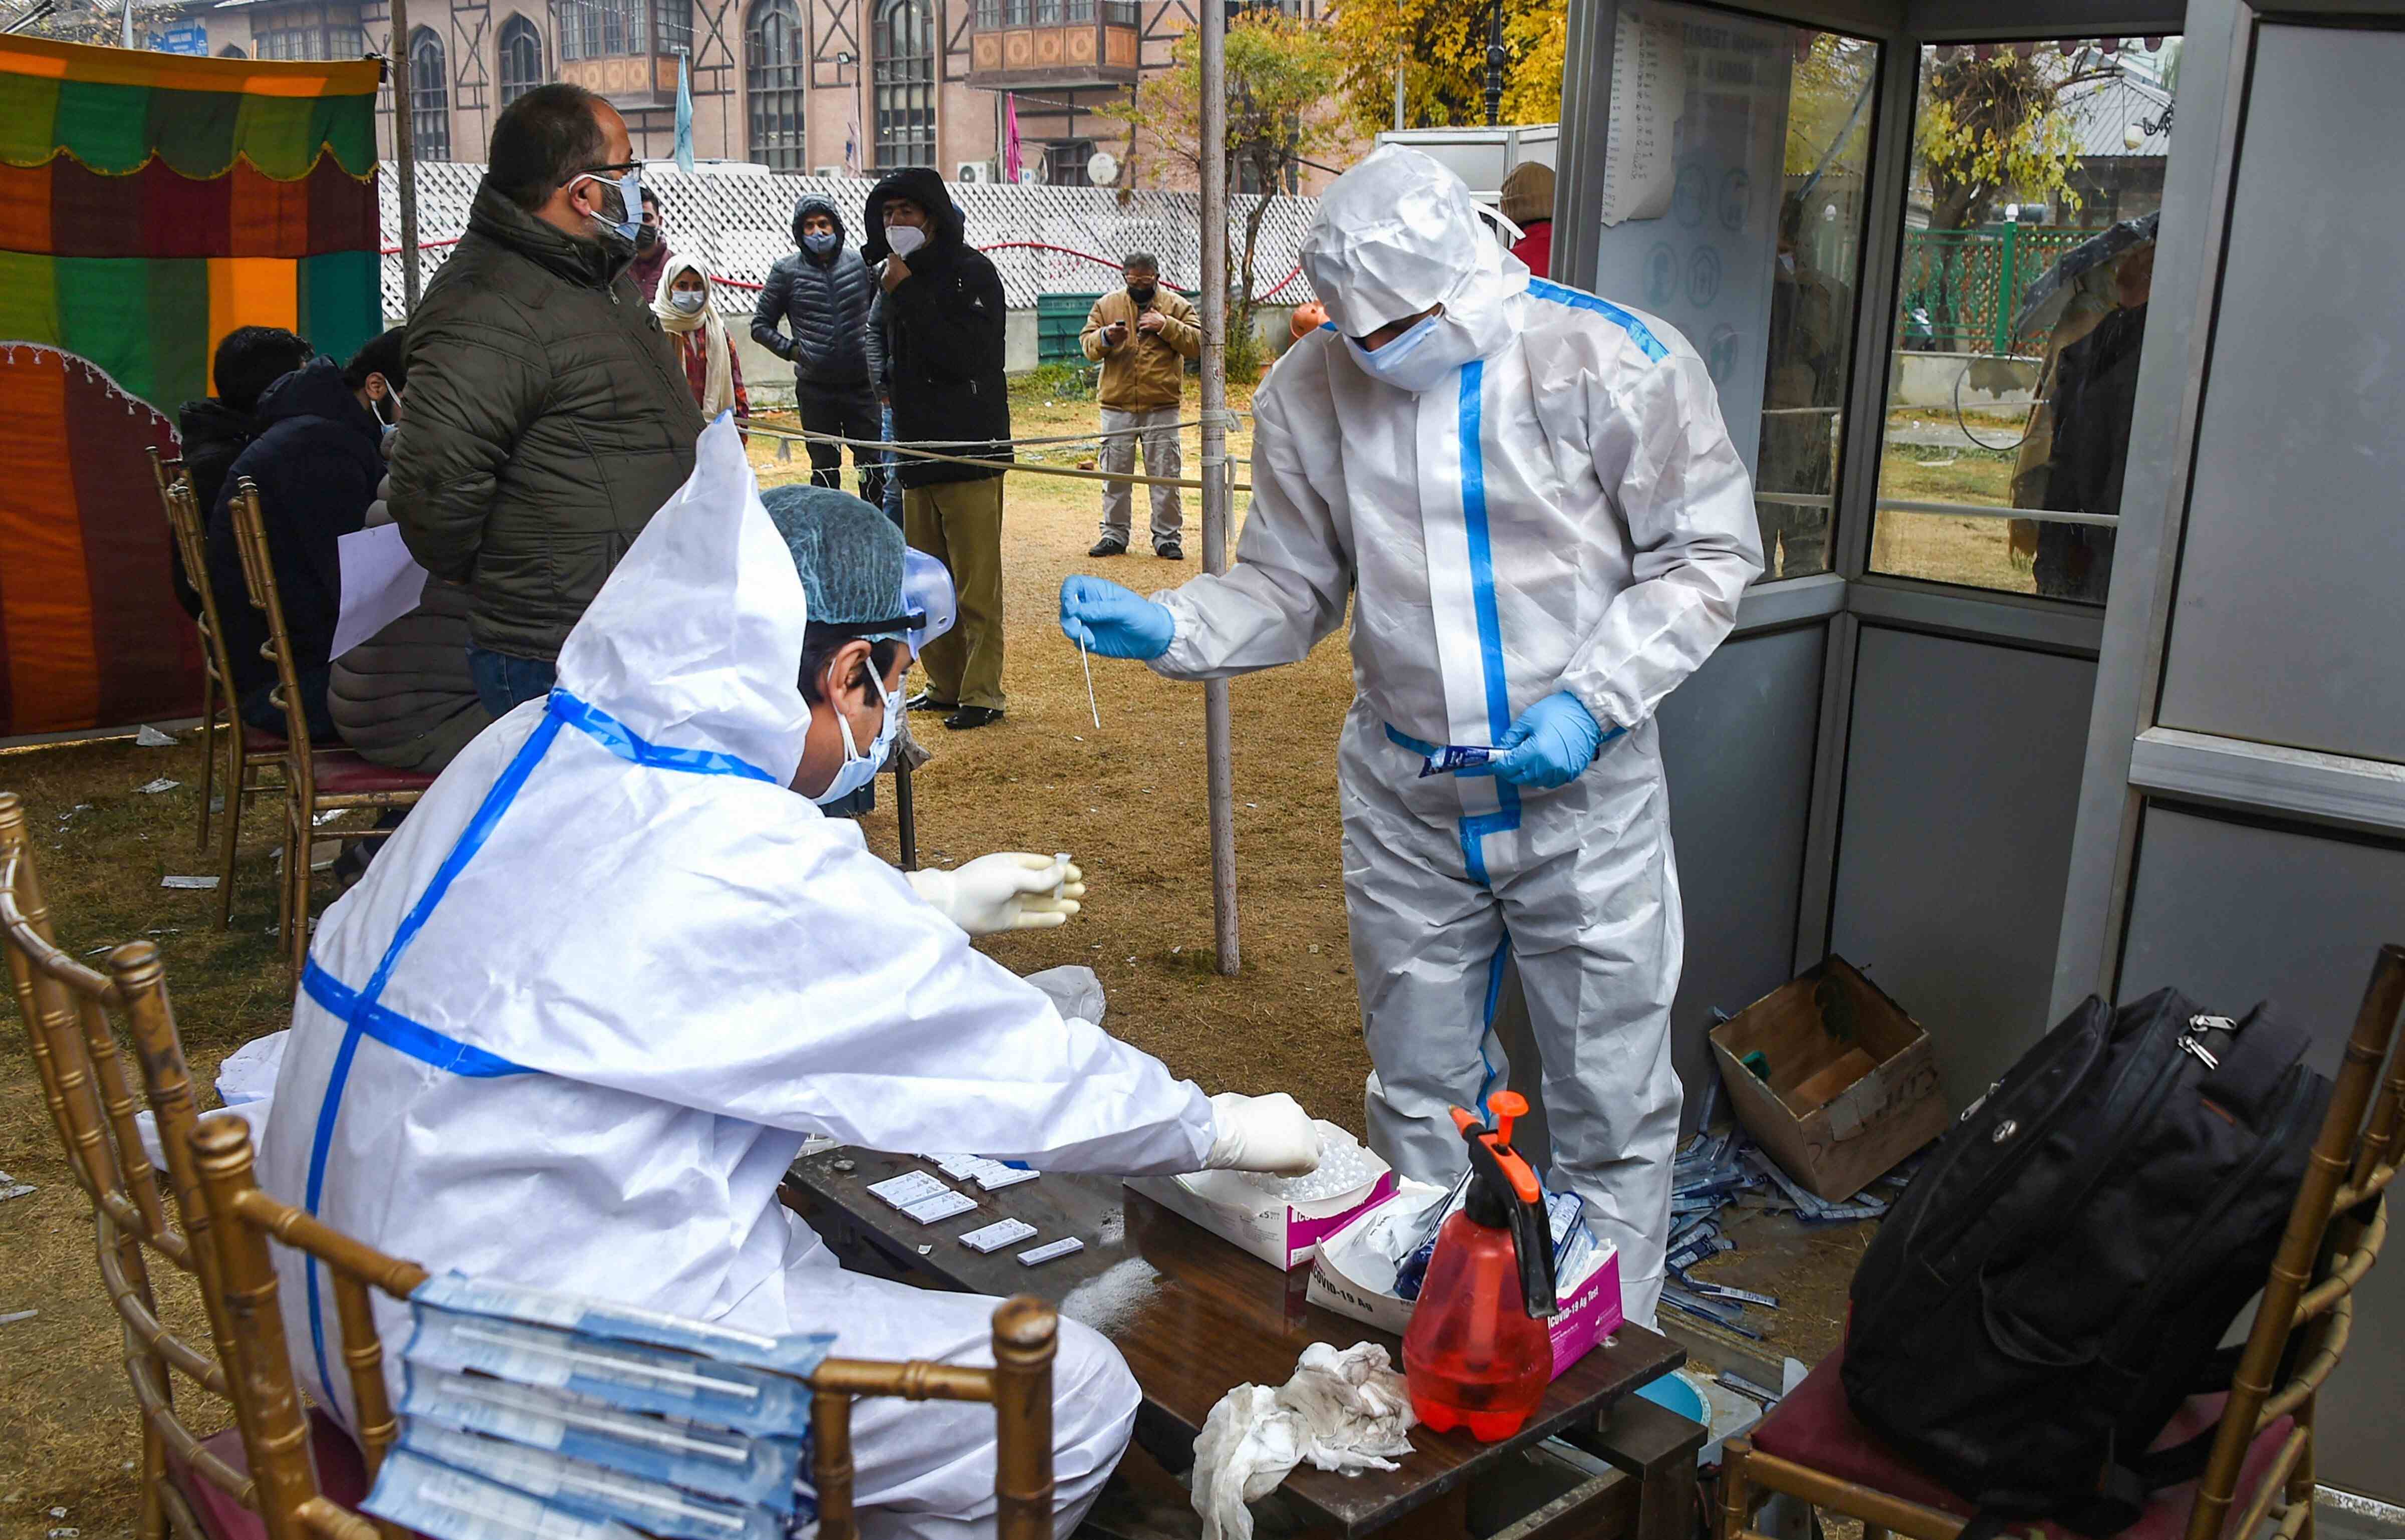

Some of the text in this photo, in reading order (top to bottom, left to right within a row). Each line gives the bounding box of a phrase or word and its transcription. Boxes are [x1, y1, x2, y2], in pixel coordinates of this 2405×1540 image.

[1314, 1266, 1373, 1313] COVID-19 Ag
[1550, 1285, 1599, 1328] COVID-19 Ag Test
